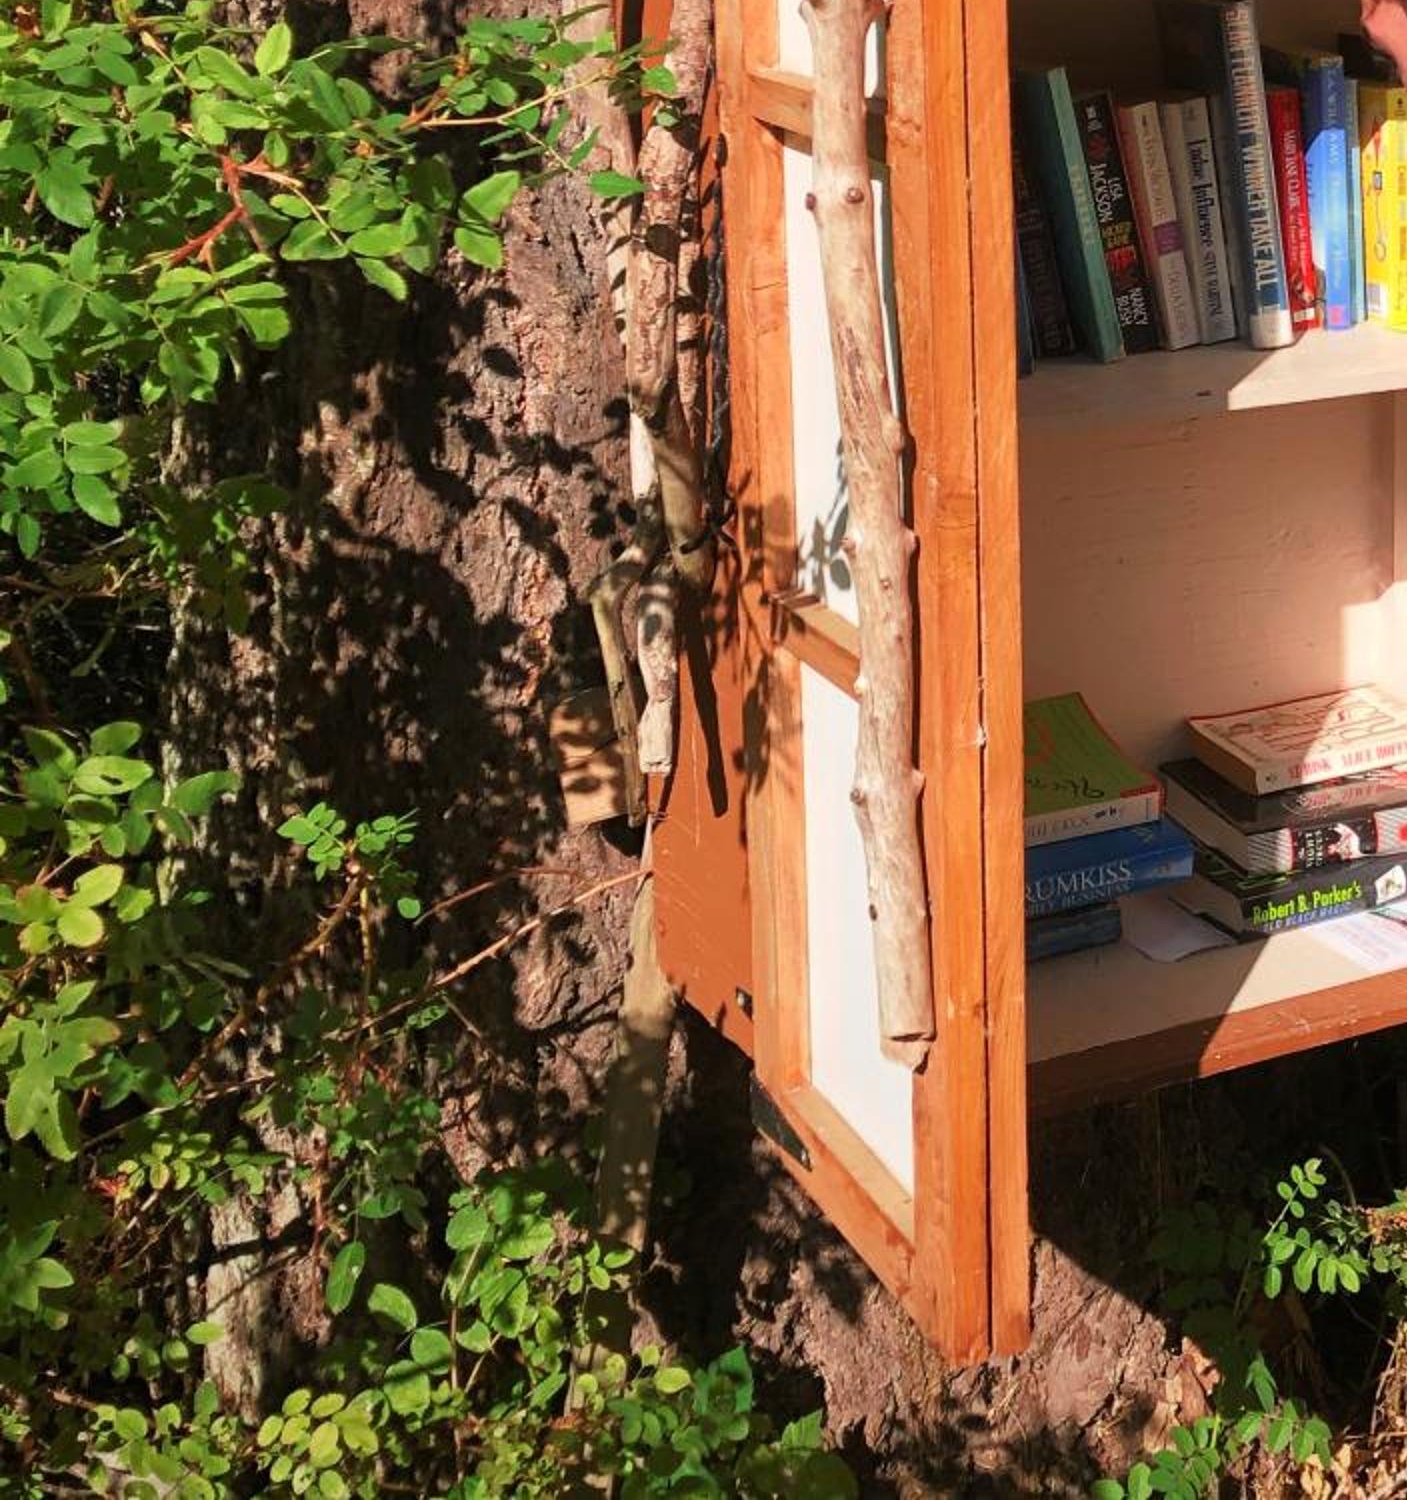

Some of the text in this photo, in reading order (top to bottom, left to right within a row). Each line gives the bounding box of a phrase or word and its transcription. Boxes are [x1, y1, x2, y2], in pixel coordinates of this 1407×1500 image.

[1089, 163, 1113, 223] JACKSON
[1107, 176, 1124, 201] LISA
[1191, 182, 1215, 246] Influence
[1241, 140, 1279, 291] WINNER TAKE ALL
[1129, 287, 1149, 325] NANCY
[1252, 880, 1362, 926] Robert B. Parker's
